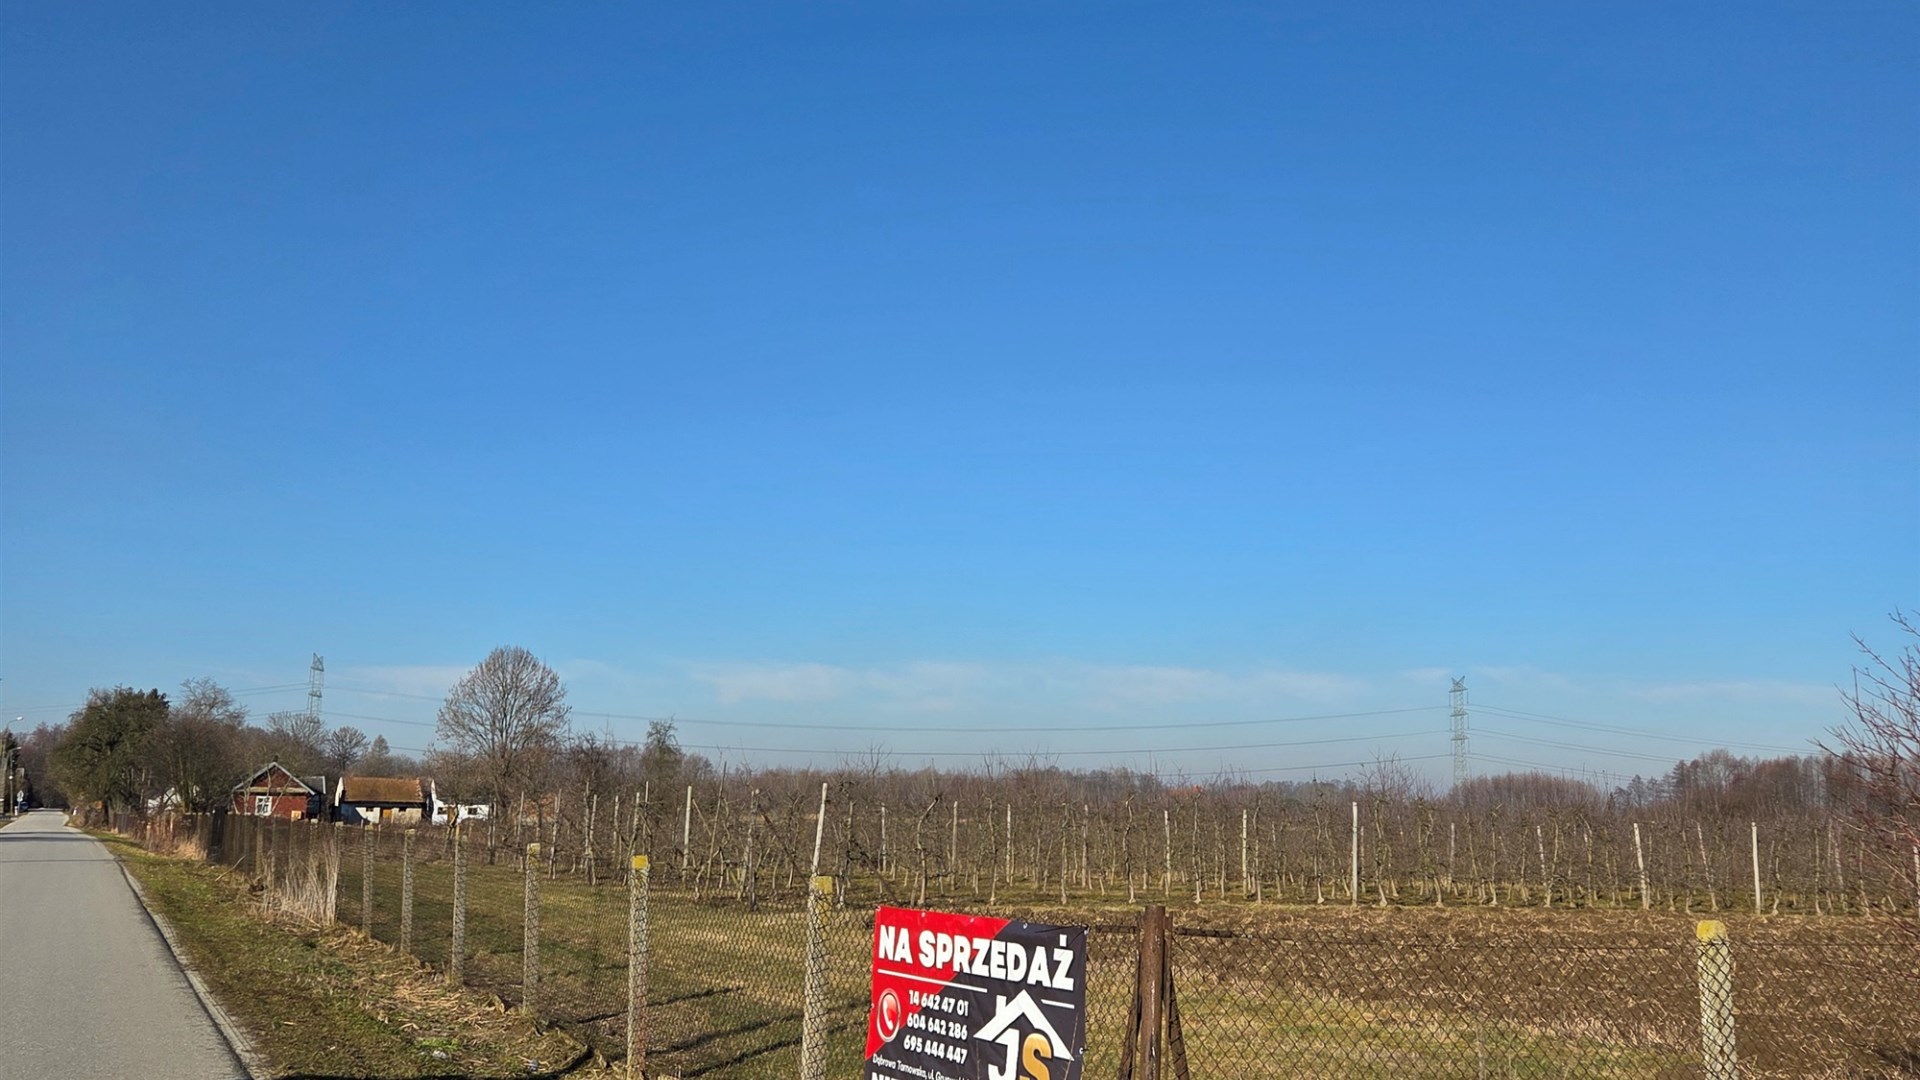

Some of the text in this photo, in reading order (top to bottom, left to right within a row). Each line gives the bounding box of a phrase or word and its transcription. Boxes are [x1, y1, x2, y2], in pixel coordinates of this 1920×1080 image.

[878, 924, 1075, 992] NA SPRZEDAŻ
[908, 989, 969, 1017] 14 642 47 01
[906, 1012, 968, 1041] 604 642 286
[872, 1053, 897, 1070] Dąbrowa
[903, 1034, 968, 1065] 695 444 447
